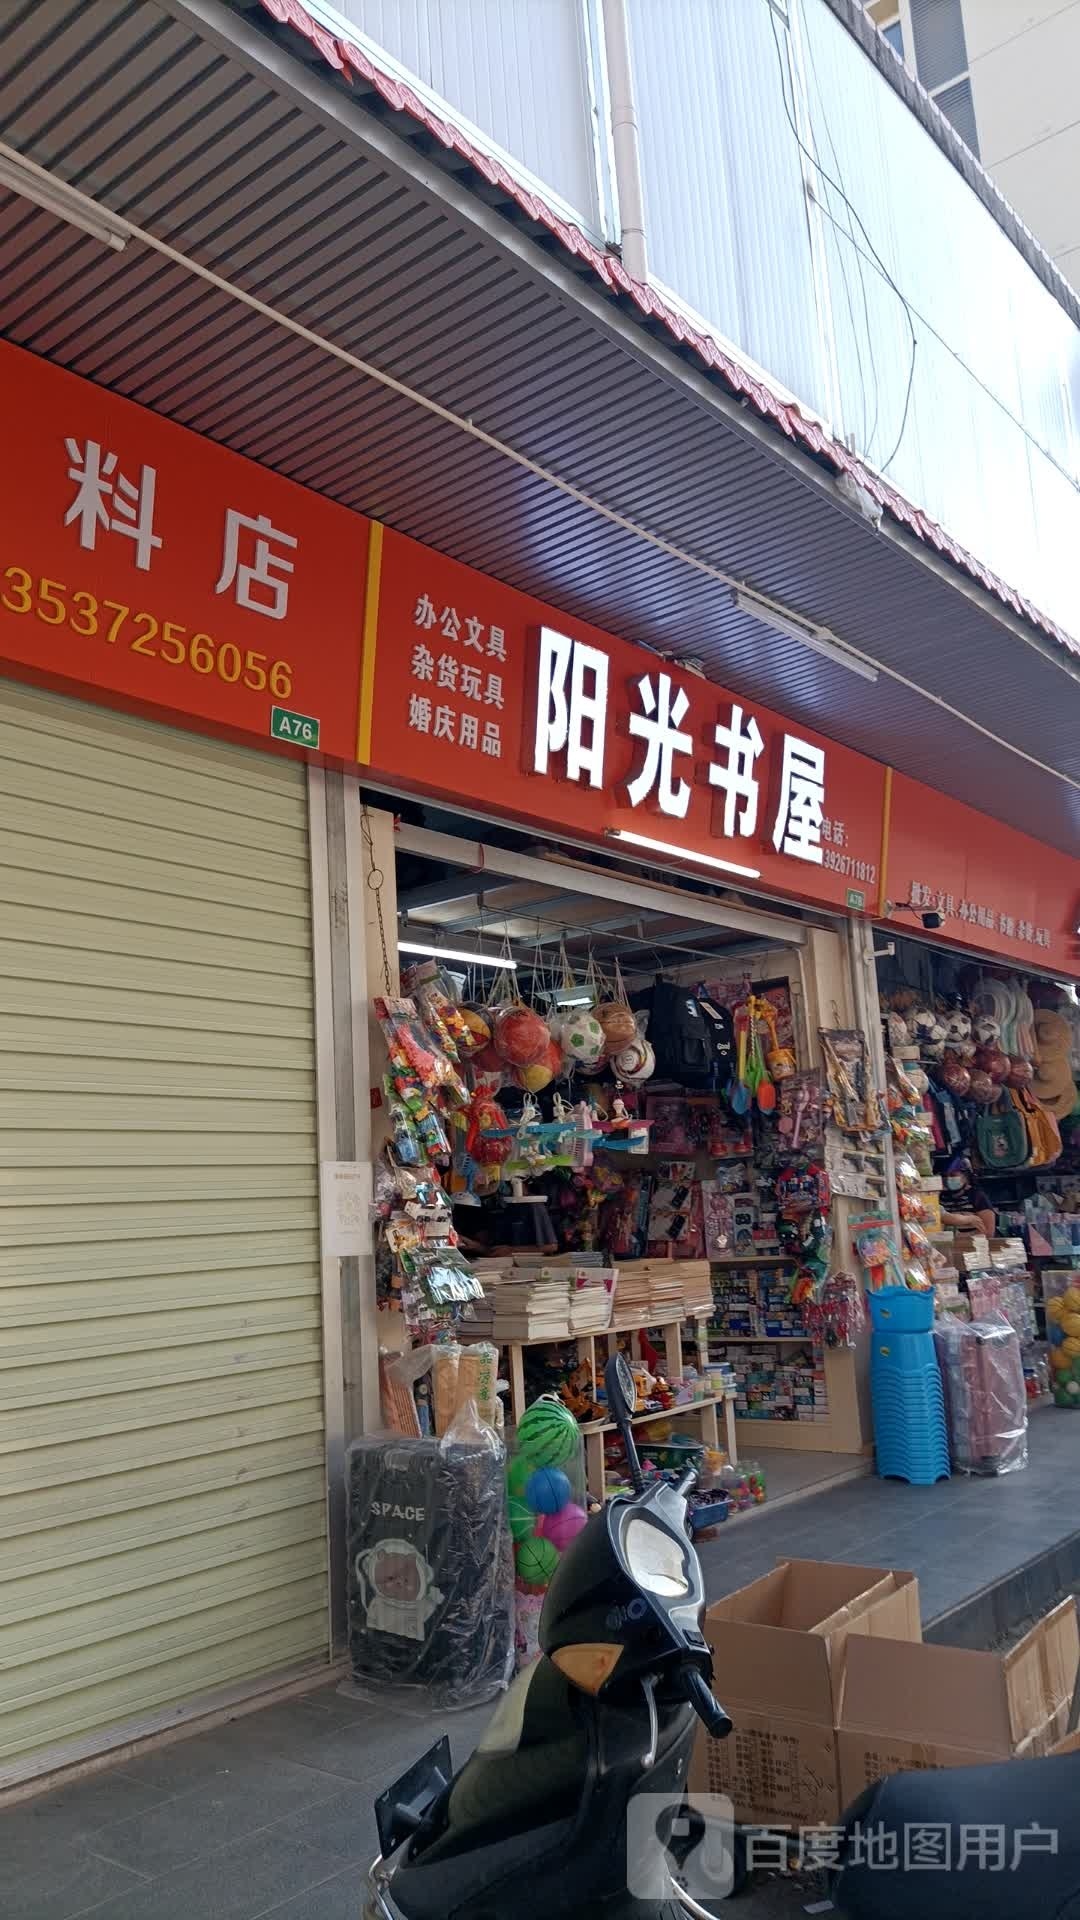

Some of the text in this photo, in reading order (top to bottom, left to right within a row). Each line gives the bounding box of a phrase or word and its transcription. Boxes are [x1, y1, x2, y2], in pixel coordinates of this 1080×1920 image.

[64, 437, 299, 621] 料店
[414, 593, 508, 663] 办公文具
[410, 643, 506, 711] 杂货玩具
[279, 716, 313, 741] A76
[407, 692, 502, 759] 婚庆用品
[533, 625, 826, 865] 阳光书屋
[821, 848, 877, 885] 3926711812
[370, 1501, 425, 1522] SPACE
